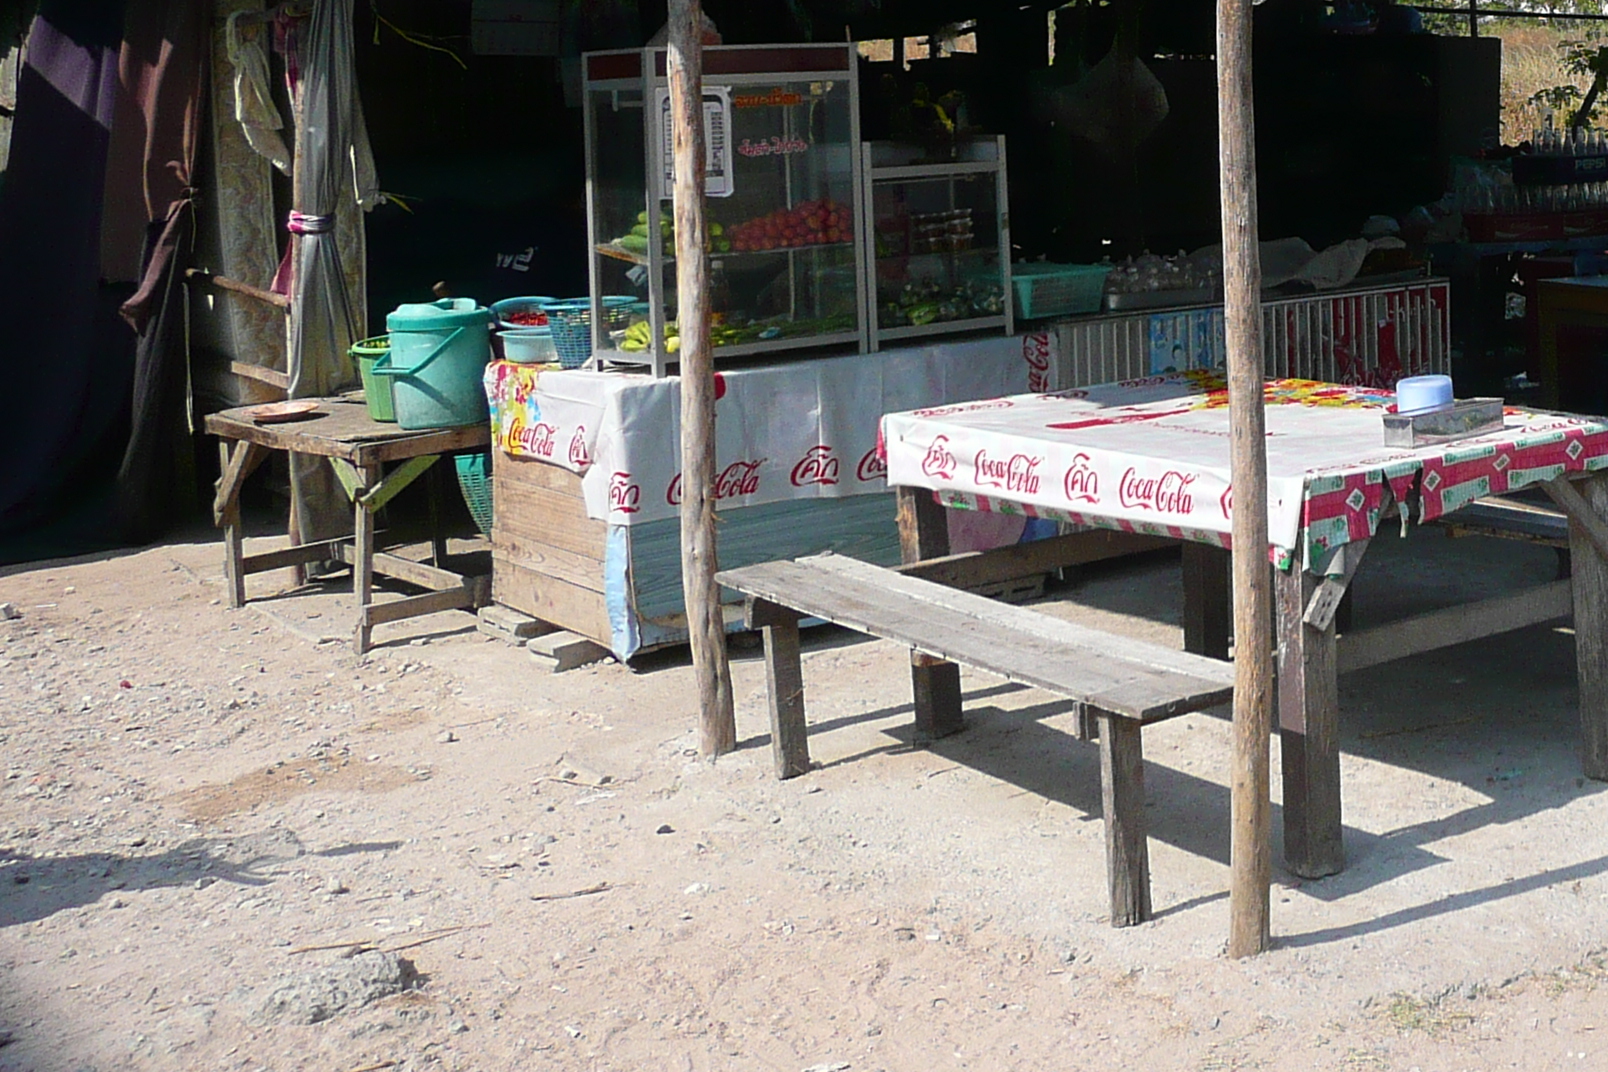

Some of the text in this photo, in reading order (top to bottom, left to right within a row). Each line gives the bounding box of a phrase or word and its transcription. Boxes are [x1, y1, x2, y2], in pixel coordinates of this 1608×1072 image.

[1575, 157, 1606, 170] PEPSI
[974, 448, 1044, 495] Coca-Cola
[1119, 466, 1199, 515] Coca-Cola
